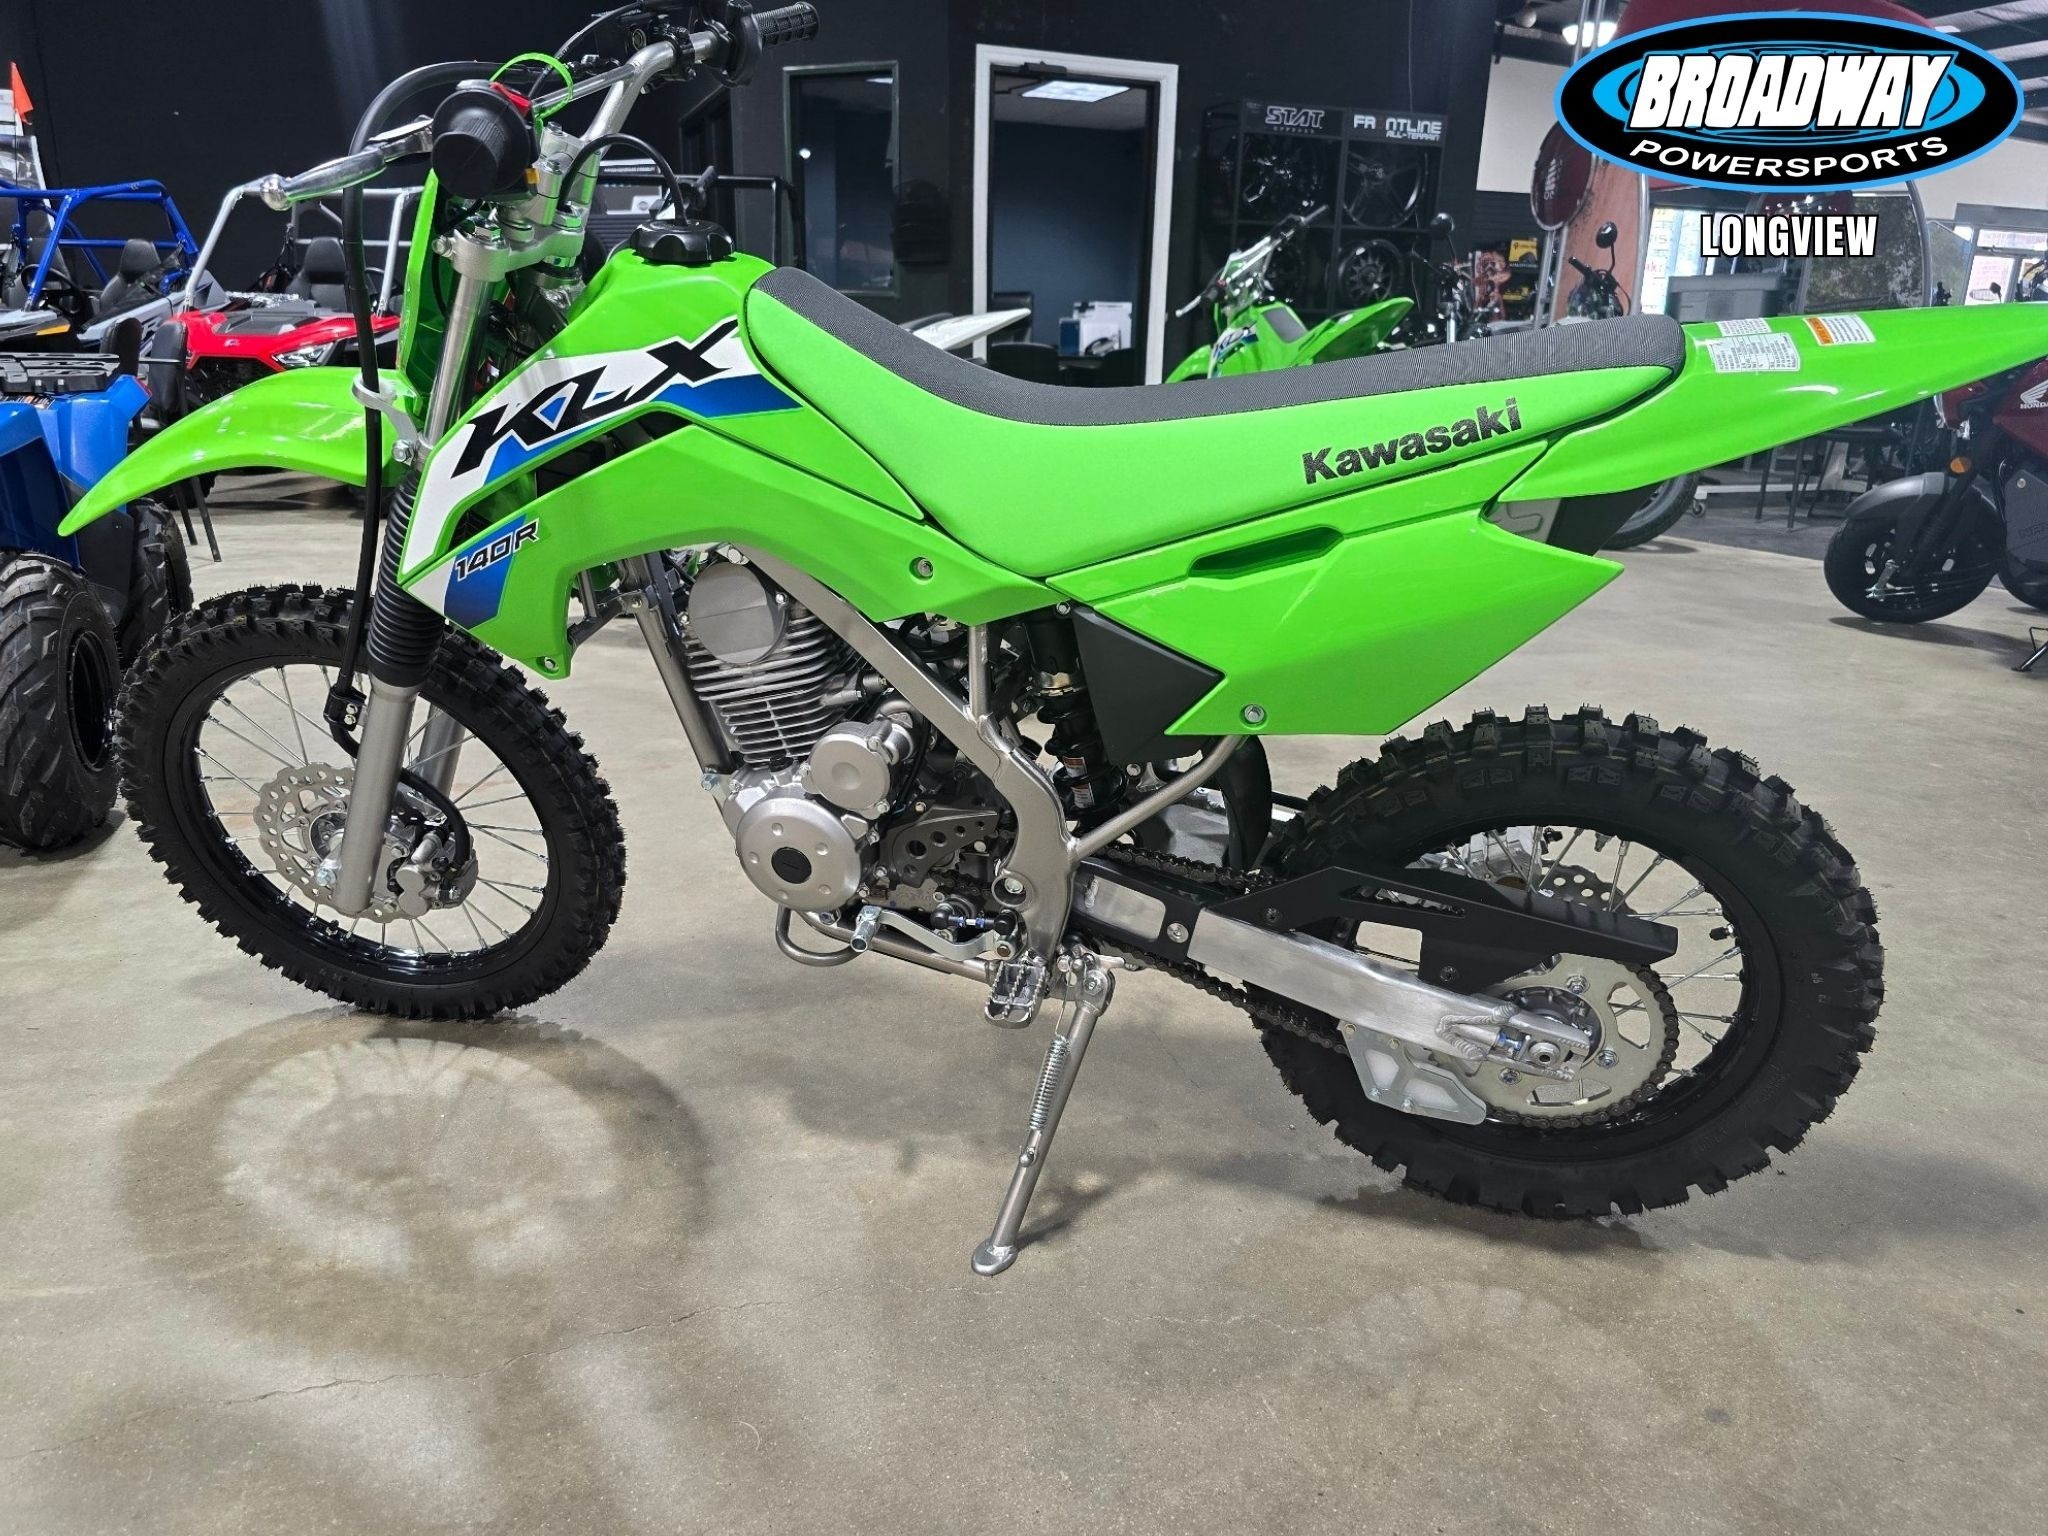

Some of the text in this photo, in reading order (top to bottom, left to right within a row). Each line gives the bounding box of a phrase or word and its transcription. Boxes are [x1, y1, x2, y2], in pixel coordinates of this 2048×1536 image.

[1265, 106, 1325, 128] STAT
[1353, 114, 1442, 134] FRNTLINE
[451, 319, 738, 479] KLX
[1302, 397, 1522, 484] Kawasaki
[454, 517, 540, 582] 140R
